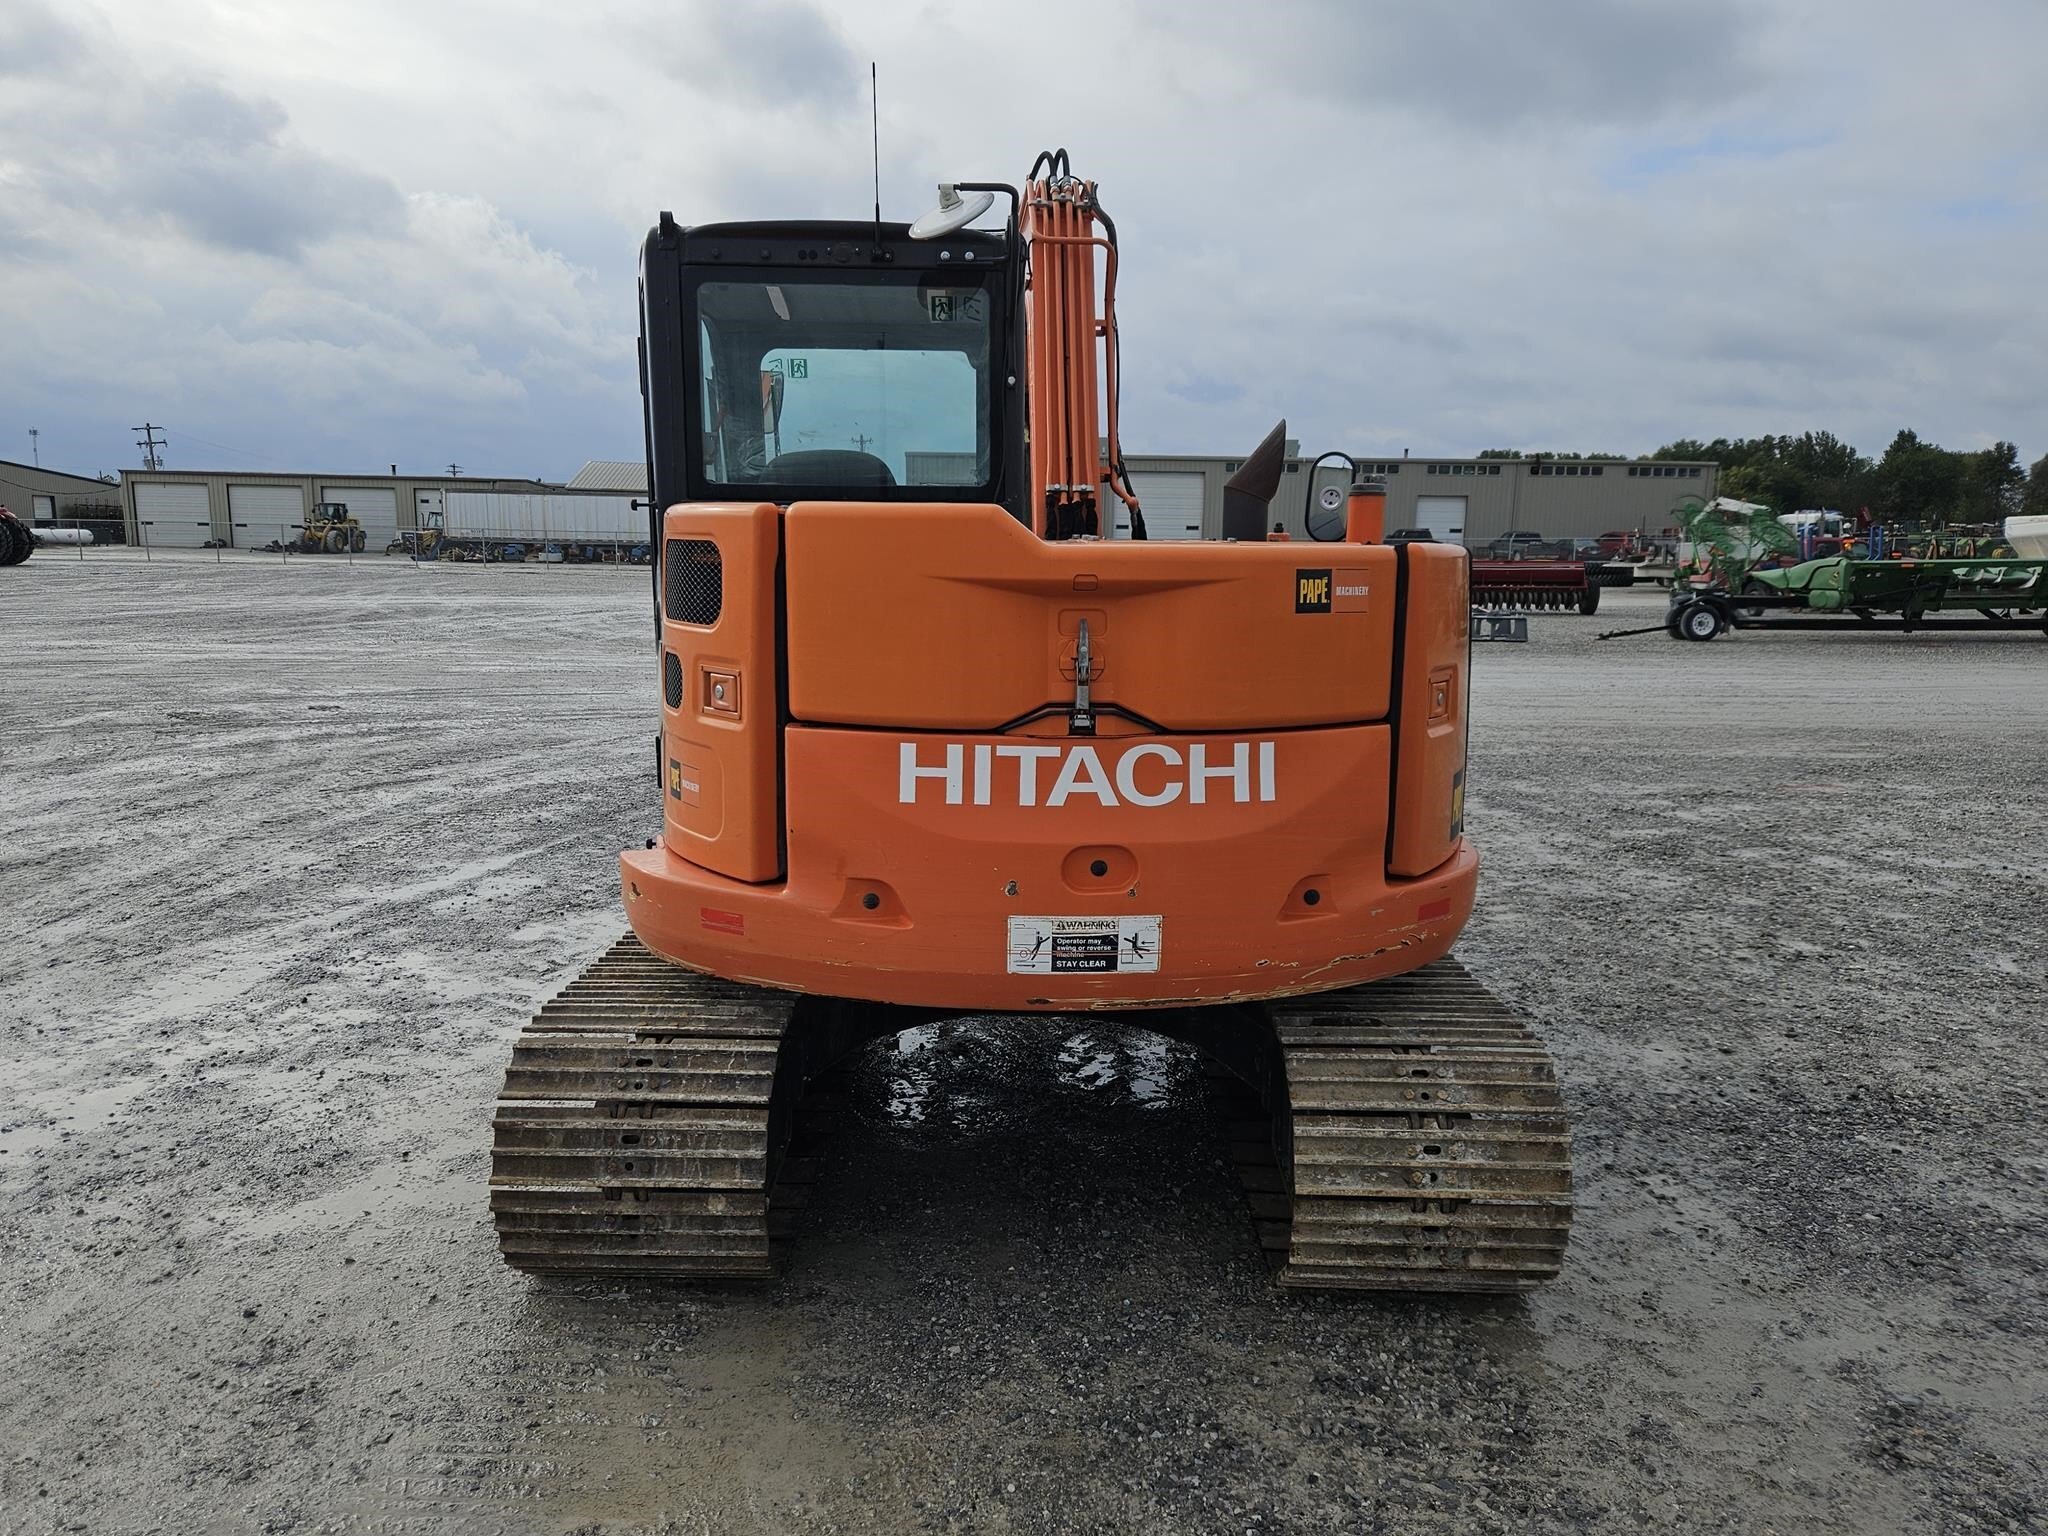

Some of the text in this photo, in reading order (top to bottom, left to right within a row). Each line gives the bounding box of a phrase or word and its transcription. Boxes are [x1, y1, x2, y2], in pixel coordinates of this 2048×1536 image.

[899, 742, 1275, 807] HITACHI
[1066, 920, 1116, 930] WARNING
[1056, 937, 1087, 945] Operator
[1056, 960, 1106, 968] STAY CLEAR
